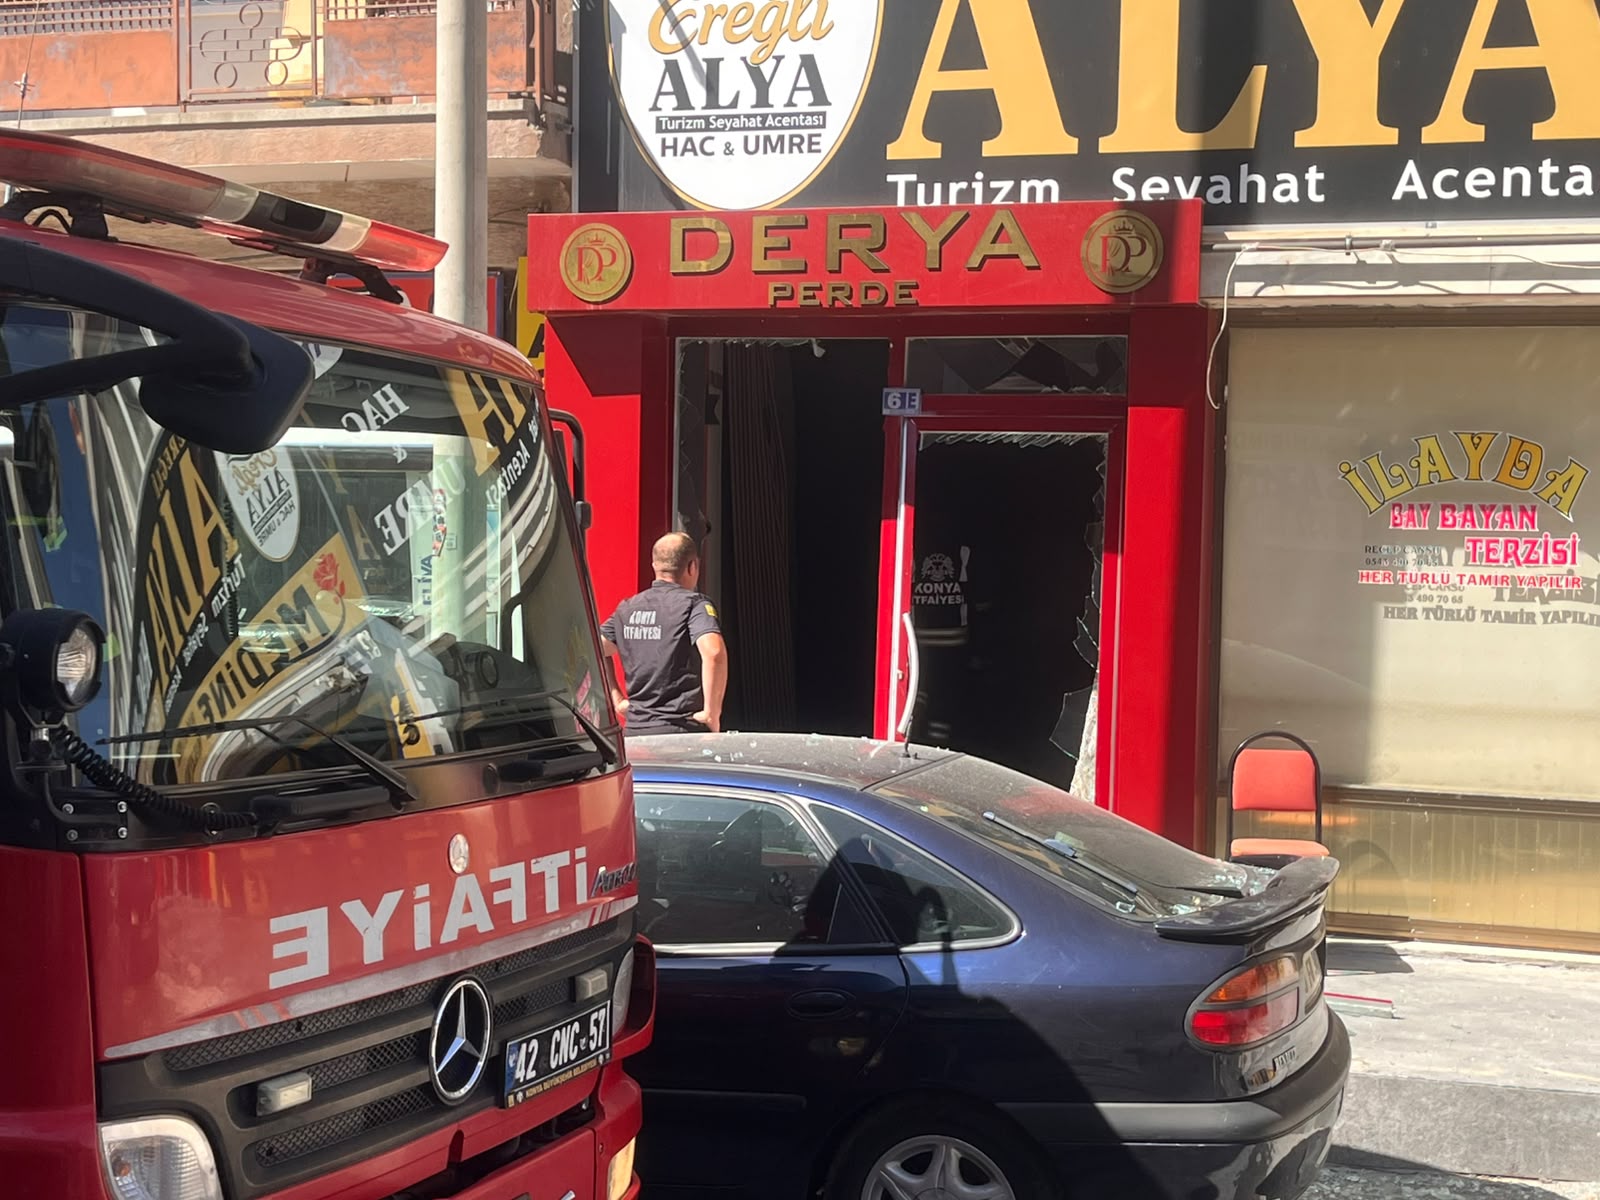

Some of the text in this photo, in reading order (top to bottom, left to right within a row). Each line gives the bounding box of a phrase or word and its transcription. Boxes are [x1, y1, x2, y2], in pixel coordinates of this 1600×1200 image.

[649, 54, 832, 112] ALYA
[885, 0, 1600, 162] ALYA
[659, 113, 824, 132] Turizm Seyahat Acentası
[661, 133, 822, 157] HAC & UMRE
[886, 172, 1061, 207] Turizm
[1392, 158, 1594, 201] Acenta
[669, 210, 1041, 275] DERYA
[768, 281, 920, 307] PERDE
[1338, 430, 1591, 522] İLAYDA
[1389, 502, 1539, 531] BAY BAYAN
[1464, 532, 1580, 568] TERZİSİ
[914, 582, 961, 594] KONYA
[1358, 570, 1394, 585] HER
[1397, 567, 1451, 586] TÜRLÜ
[1456, 572, 1511, 588] TAMİR
[1515, 574, 1584, 590] YAPILIR
[515, 1007, 606, 1083] 42 CNC 57
